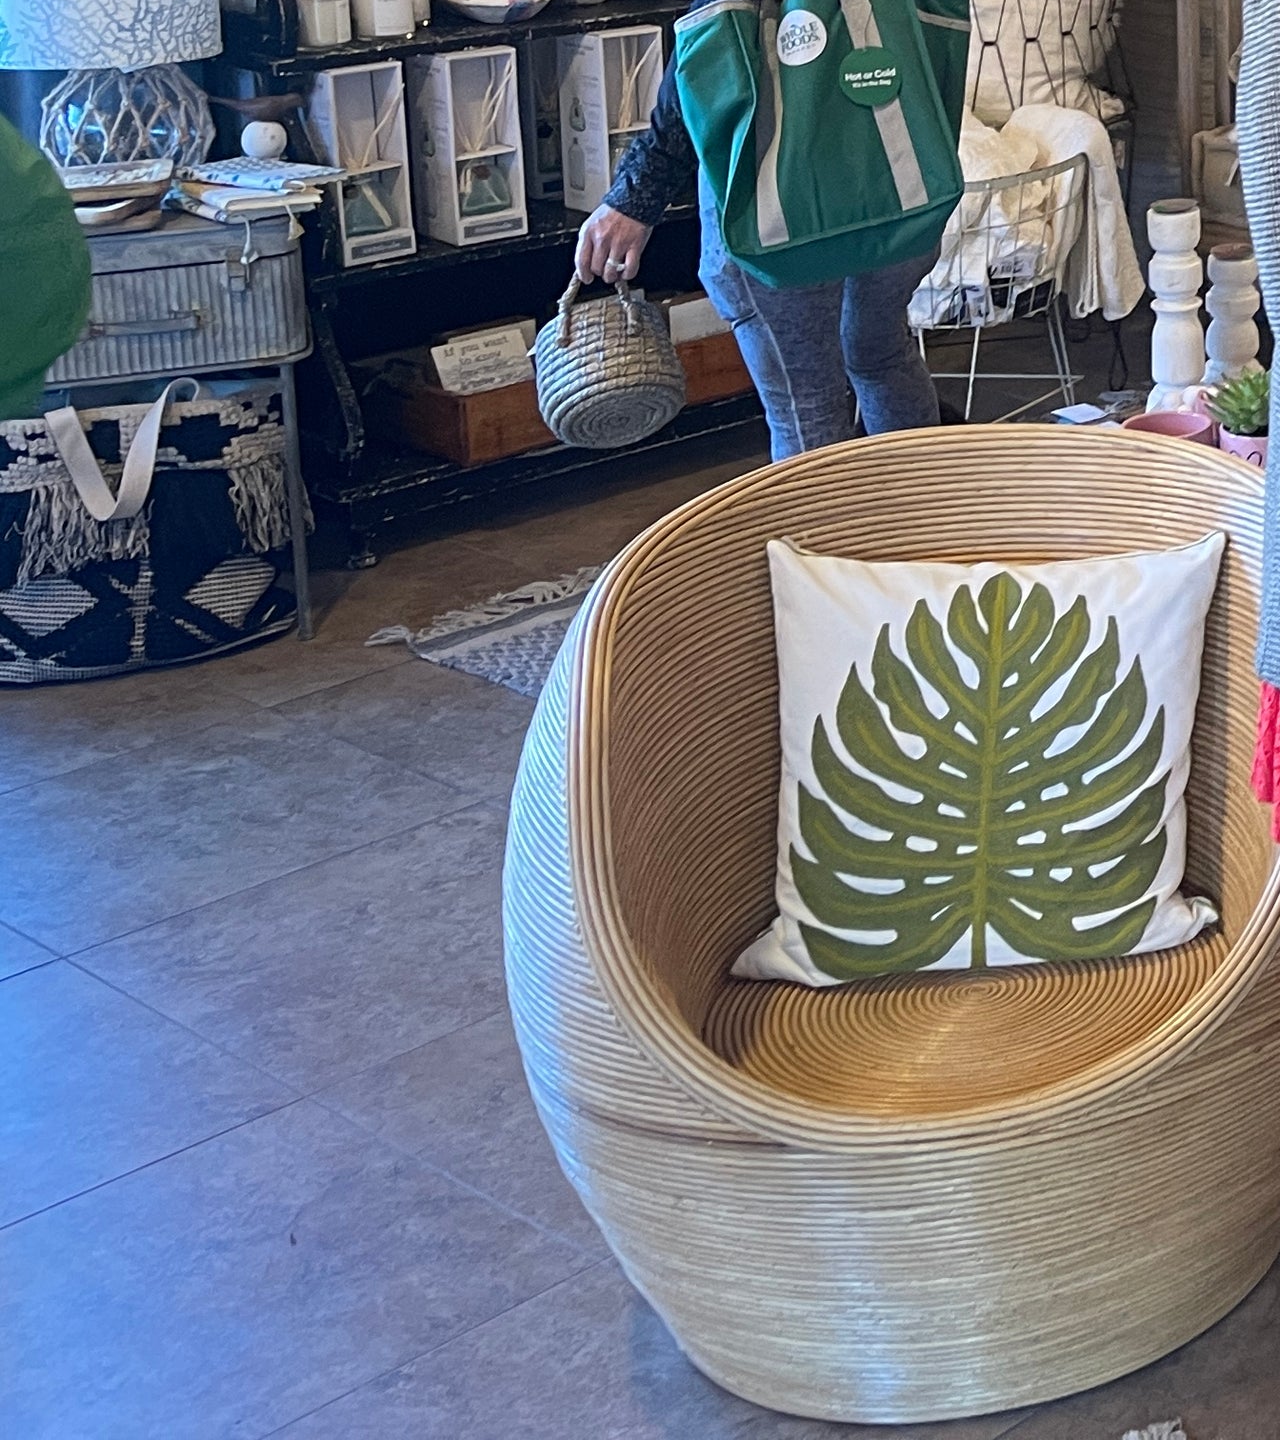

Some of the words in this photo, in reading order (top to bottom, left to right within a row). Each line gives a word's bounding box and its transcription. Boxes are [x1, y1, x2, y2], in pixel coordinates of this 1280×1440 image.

[780, 20, 819, 44] WHOLE
[780, 32, 821, 55] FOODS
[844, 71, 862, 82] Hot
[863, 72, 873, 80] or
[873, 67, 897, 79] Cold
